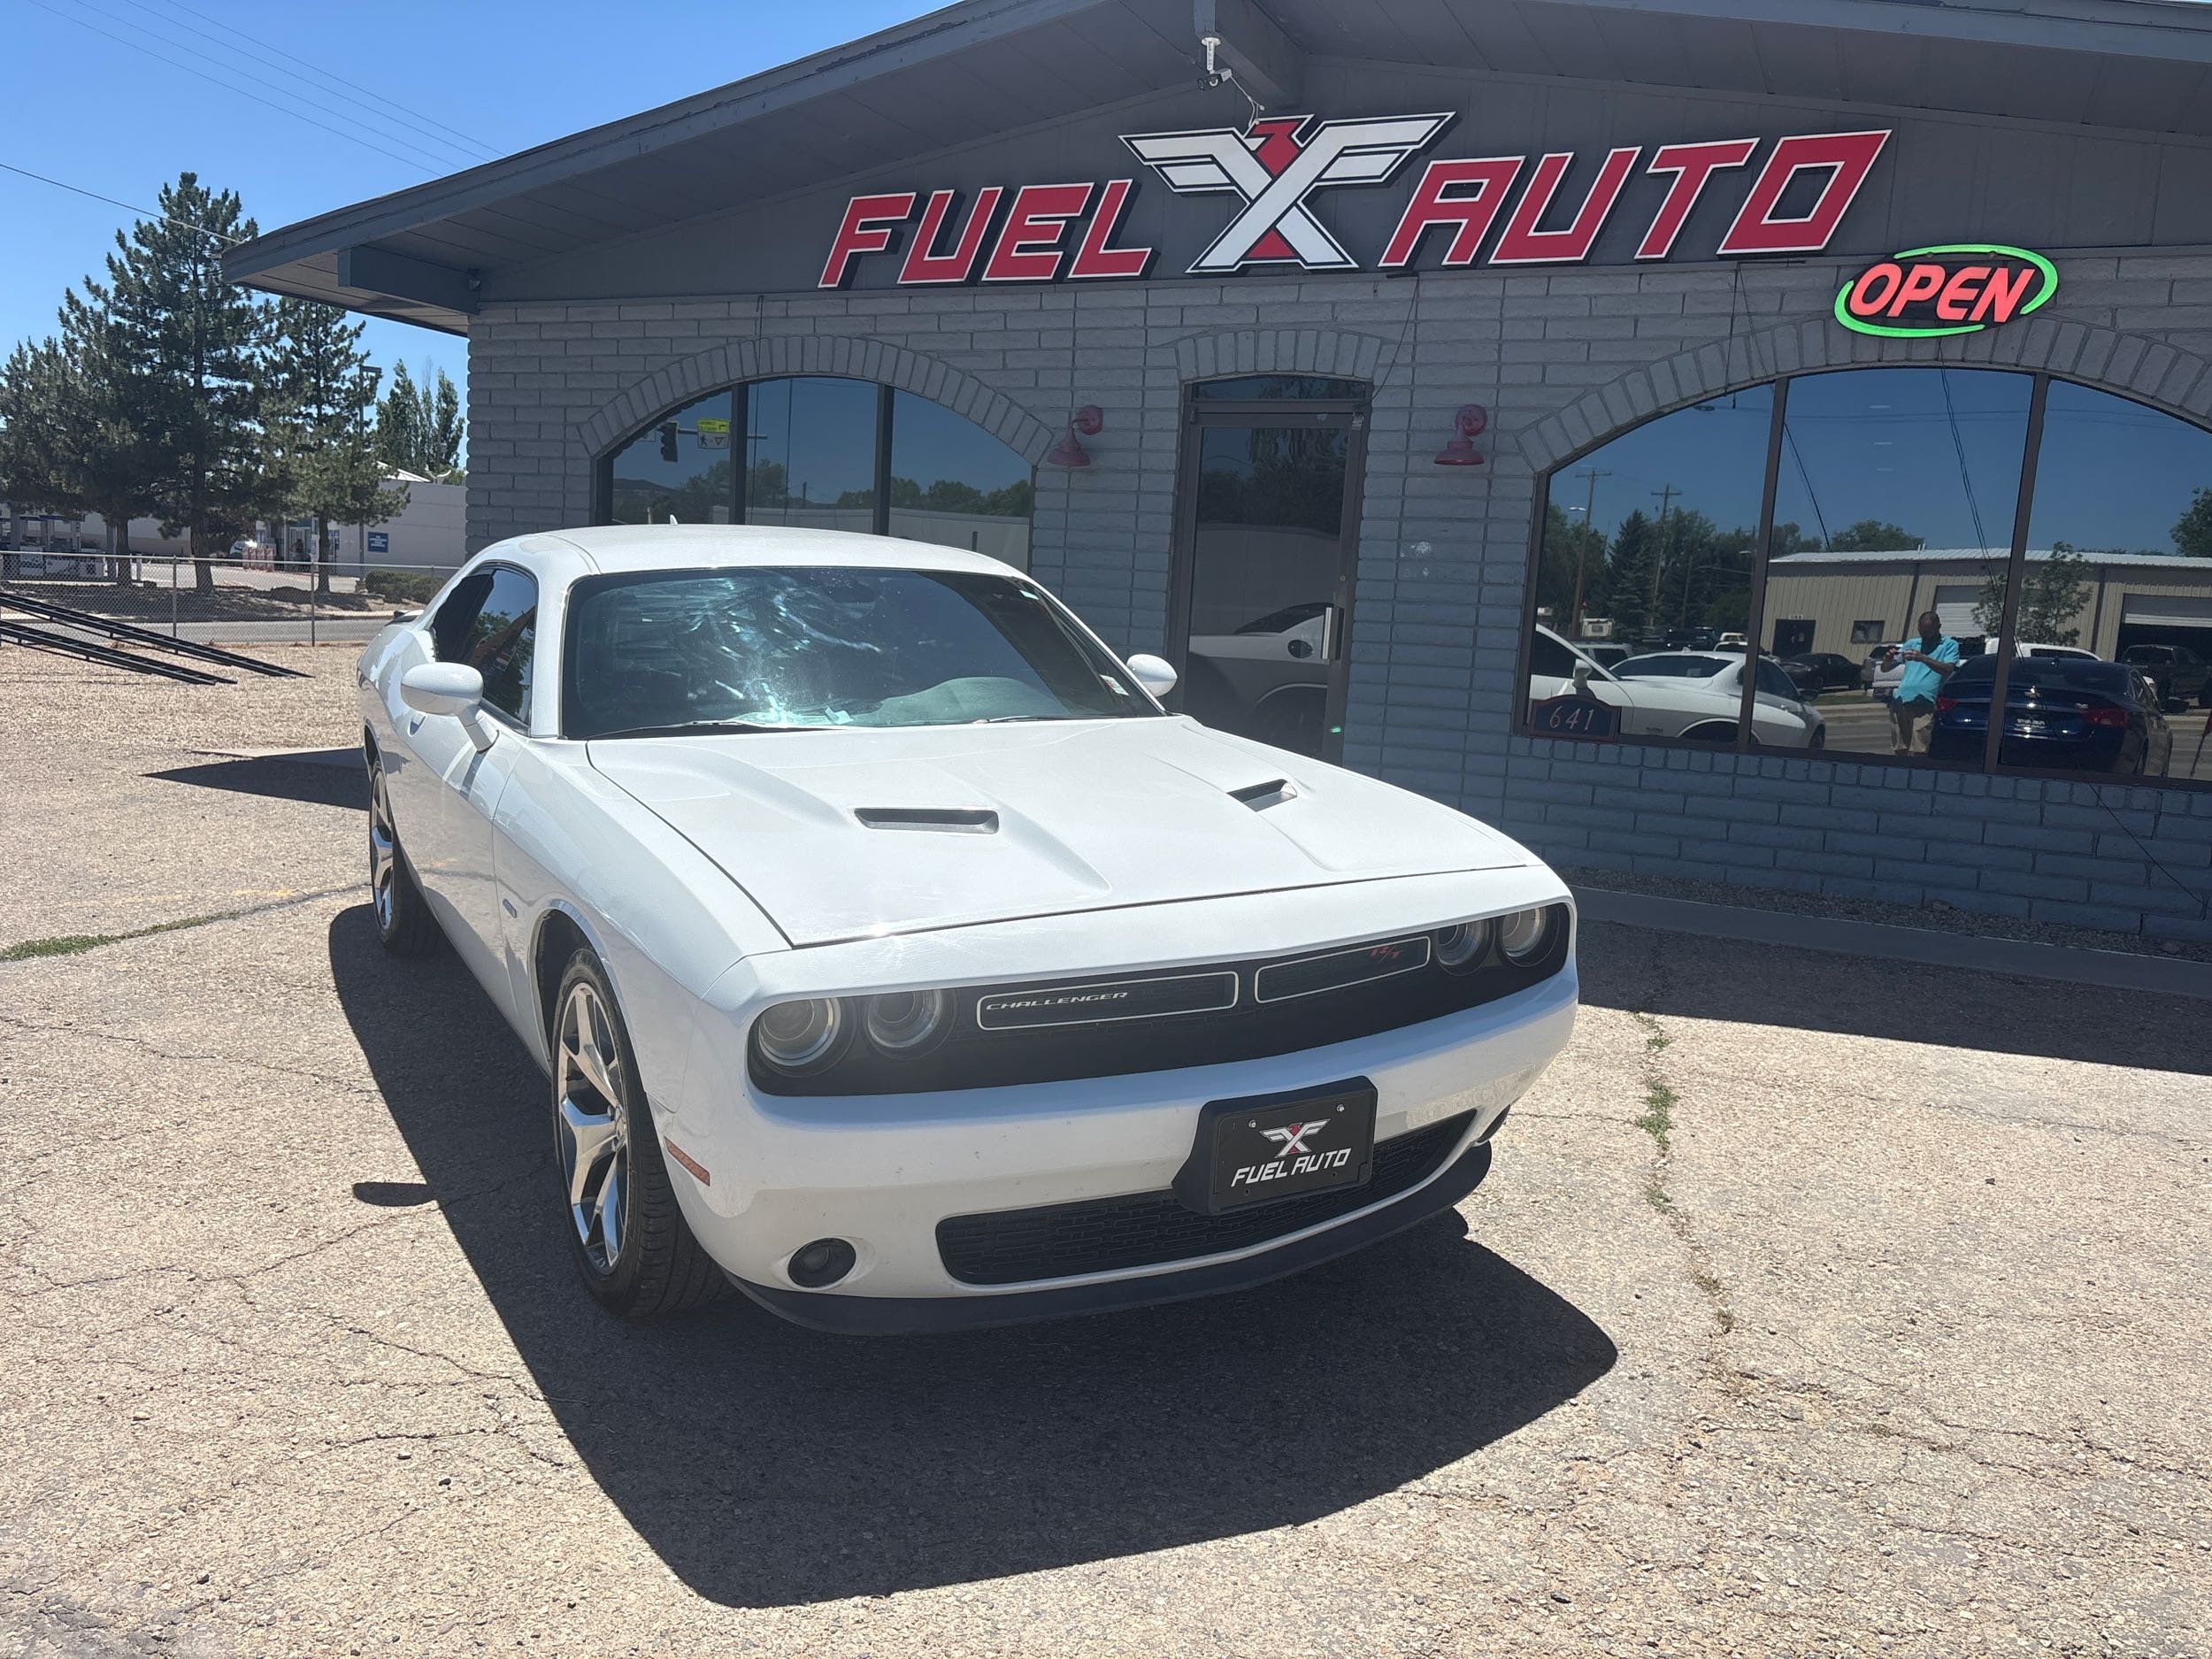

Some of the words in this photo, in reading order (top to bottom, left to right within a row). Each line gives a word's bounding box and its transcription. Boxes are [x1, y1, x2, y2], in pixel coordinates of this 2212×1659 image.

[818, 179, 1152, 288] FUEL
[1378, 129, 1893, 267] AUTO
[1849, 263, 2035, 323] OPEN
[1549, 705, 1594, 730] 641
[1370, 944, 1403, 963] R/T
[986, 991, 1128, 1010] CHALLENGER
[1231, 1160, 1288, 1187] FUEL
[1291, 1148, 1352, 1176] AUTO
